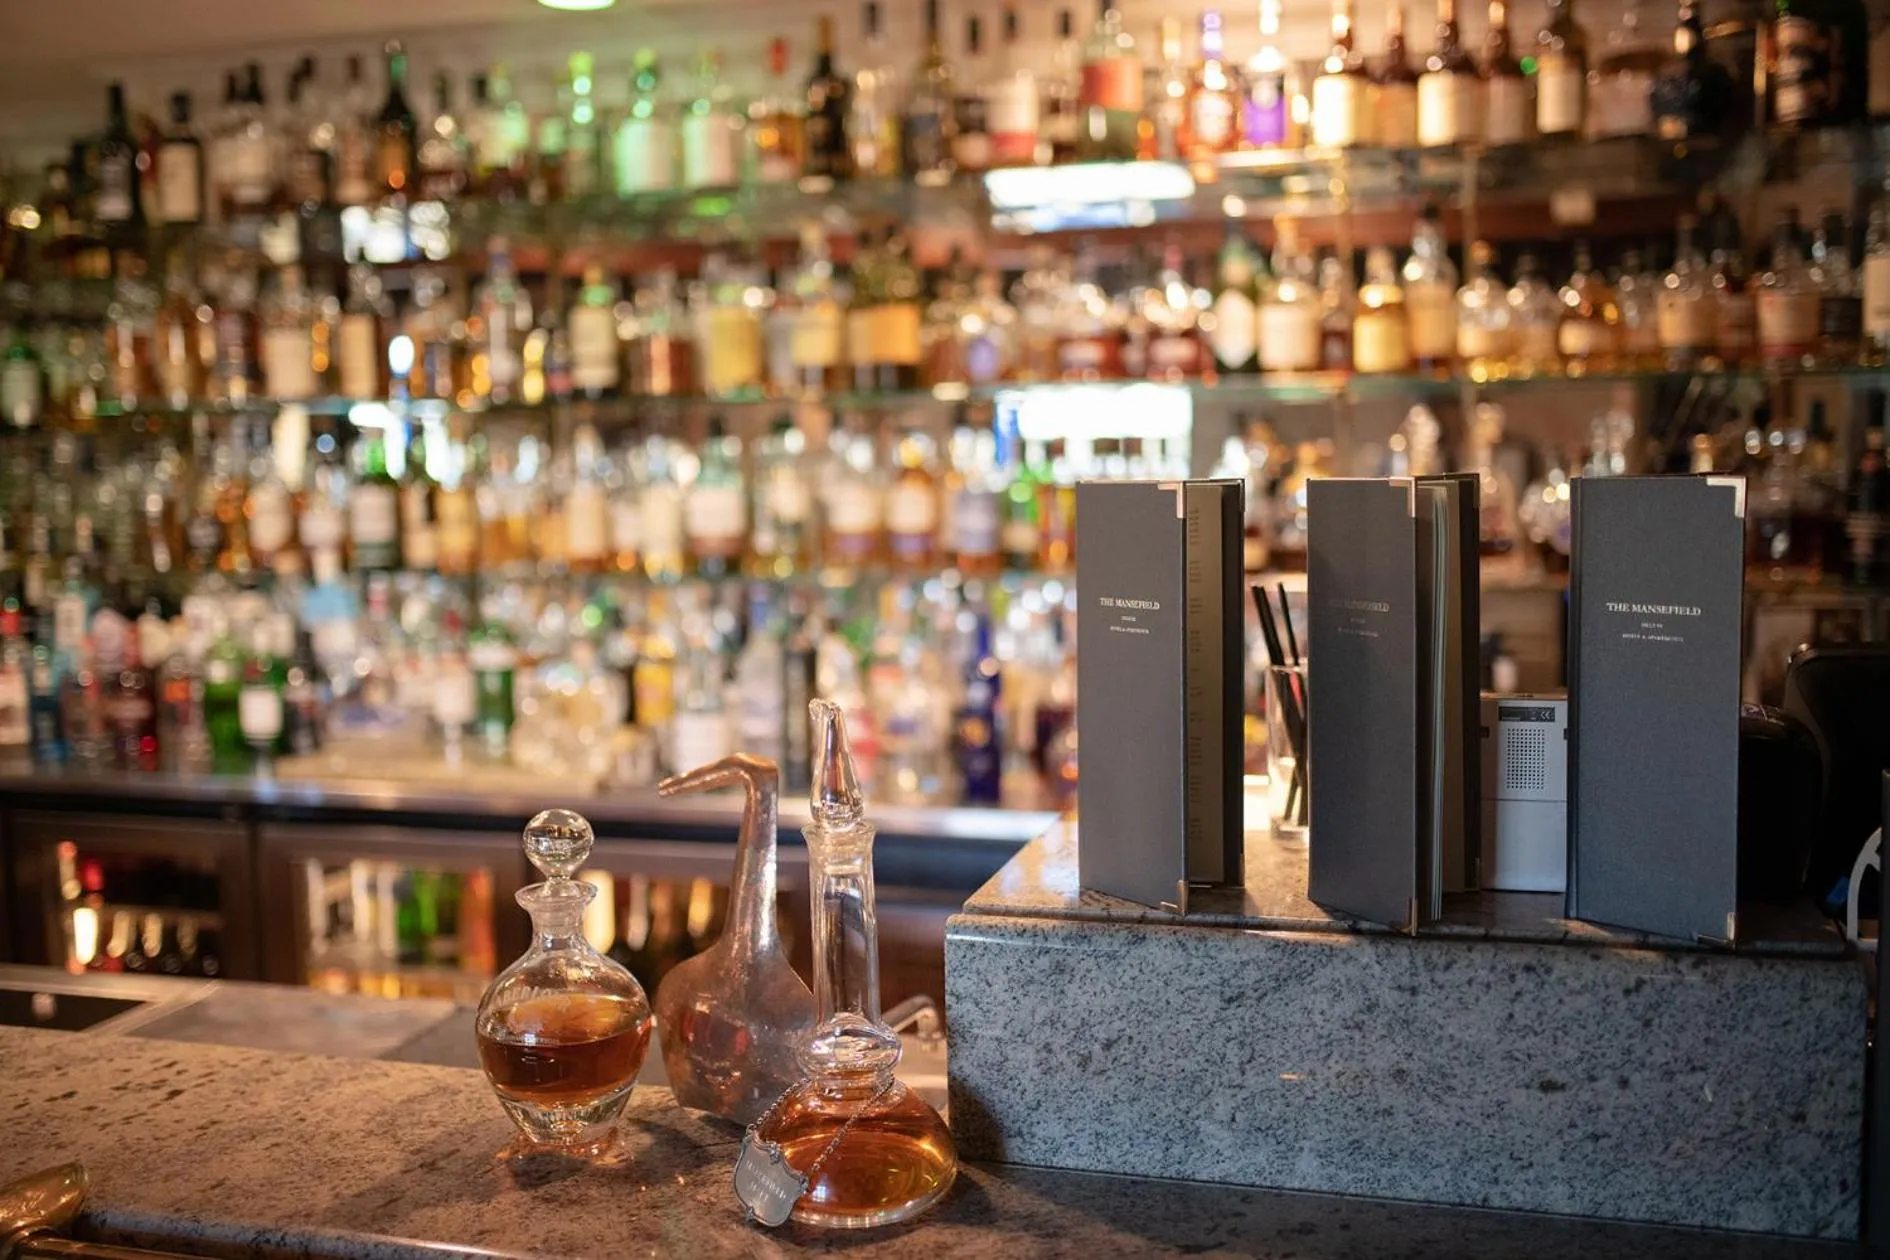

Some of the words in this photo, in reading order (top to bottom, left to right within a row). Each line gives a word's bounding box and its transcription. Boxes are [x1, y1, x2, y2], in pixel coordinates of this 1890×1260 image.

[1100, 597, 1114, 607] THE
[1606, 602, 1630, 612] THE
[1631, 604, 1702, 616] MANSEFIELD
